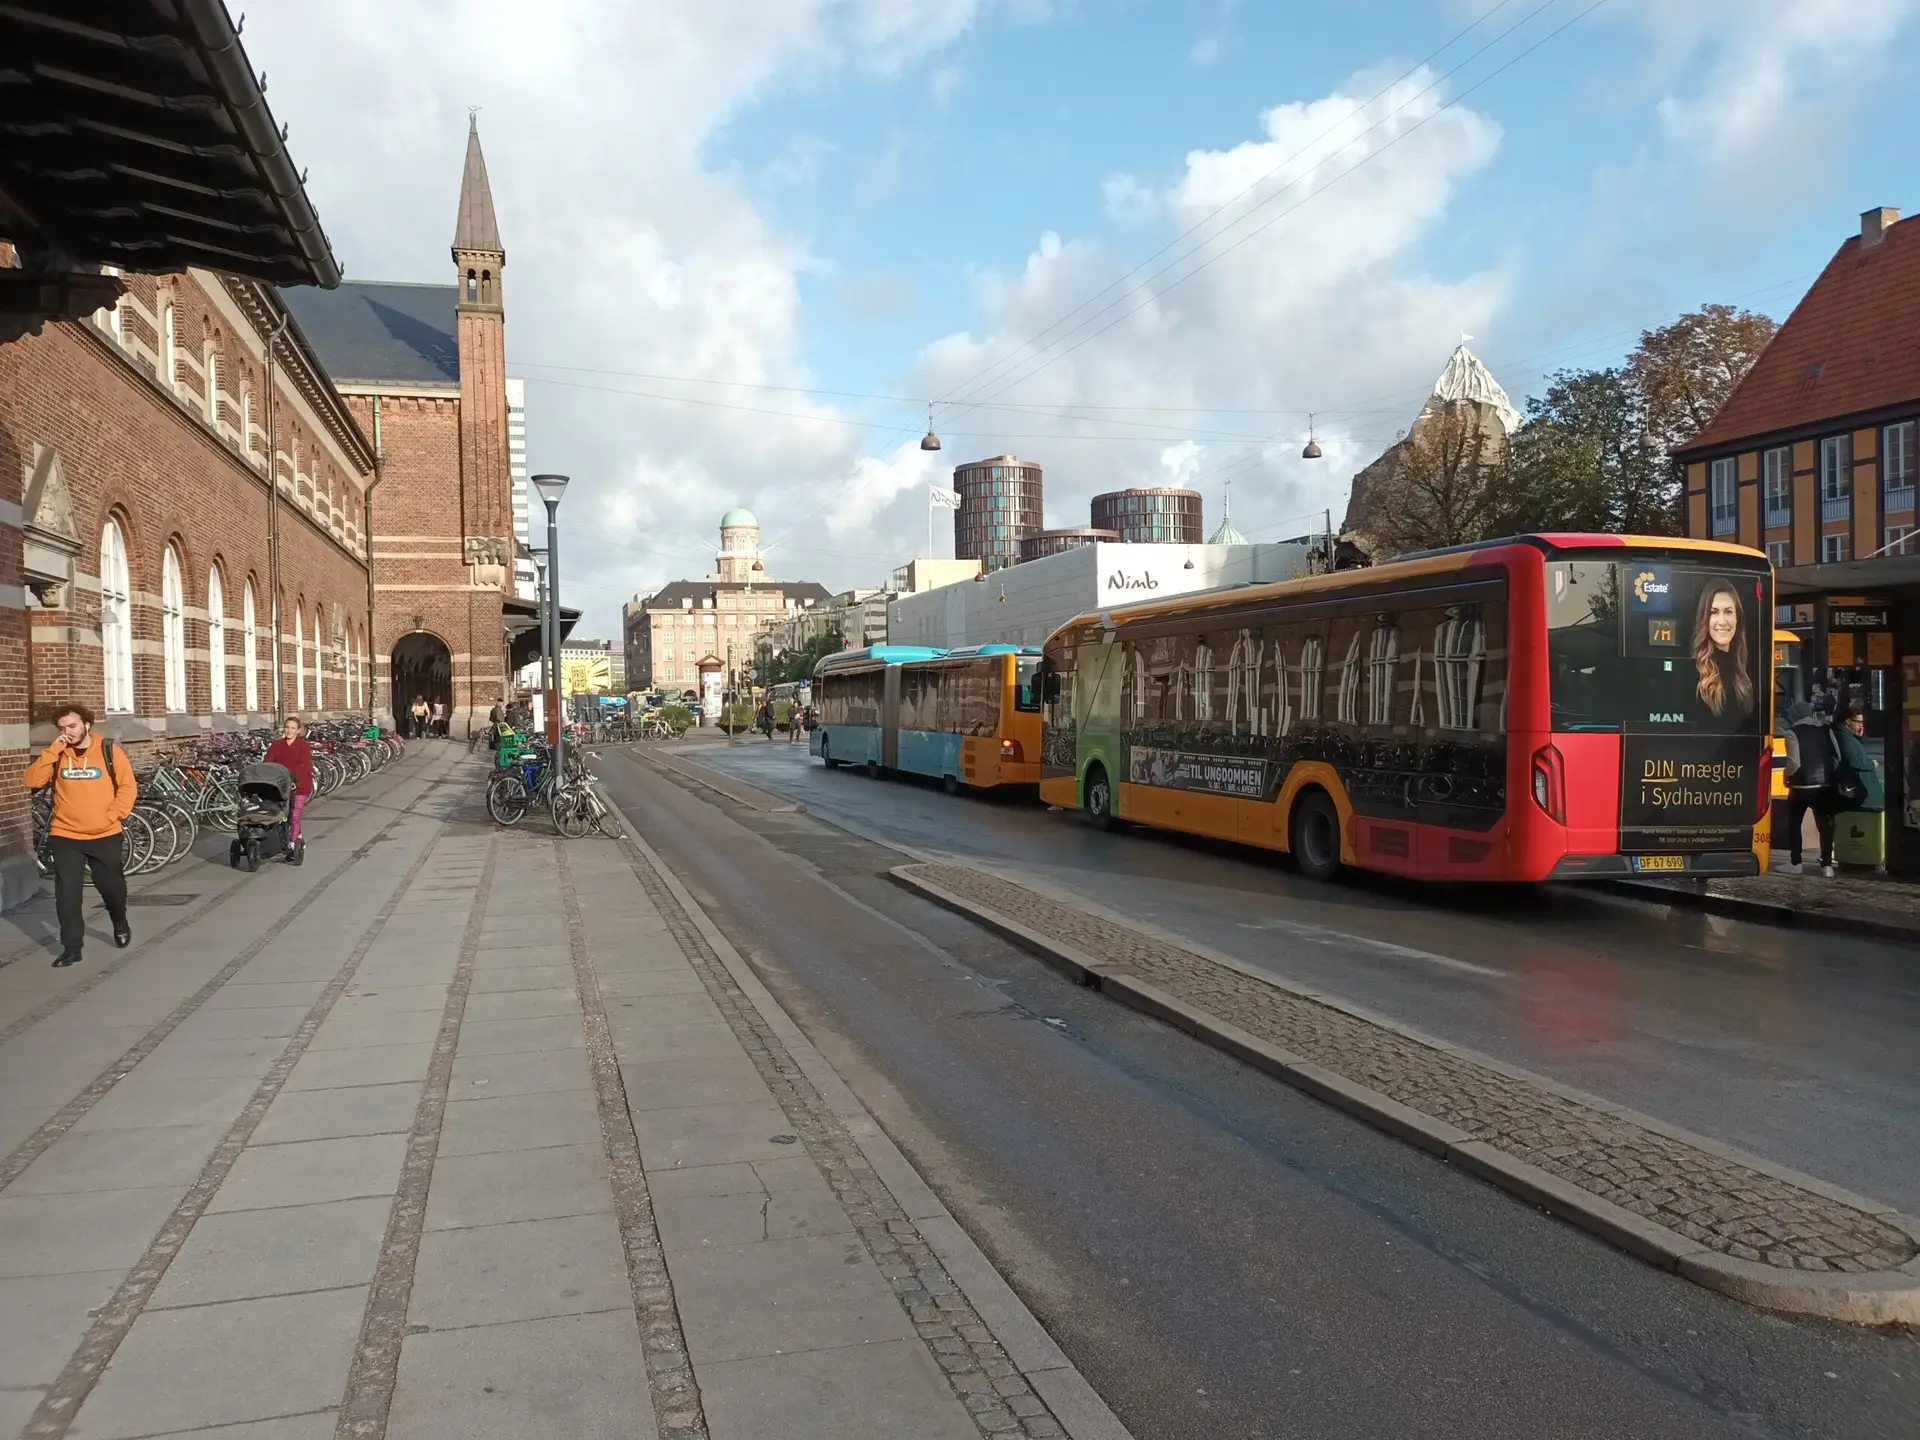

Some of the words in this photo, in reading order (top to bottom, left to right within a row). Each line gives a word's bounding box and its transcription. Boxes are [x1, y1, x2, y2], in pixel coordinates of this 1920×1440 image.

[1108, 570, 1158, 590] Nimb
[1643, 582, 1668, 594] Estate
[1649, 713, 1684, 723] MAN
[1190, 764, 1203, 779] TIL
[1204, 765, 1262, 786] UNGDOMMEN
[1644, 759, 1674, 778] DIN
[1681, 760, 1743, 783] mægler
[1641, 786, 1646, 804] i
[1652, 787, 1742, 810] Sydhavnen
[1639, 856, 1651, 868] DF
[1654, 856, 1664, 868] 67
[1667, 856, 1683, 868] 690
